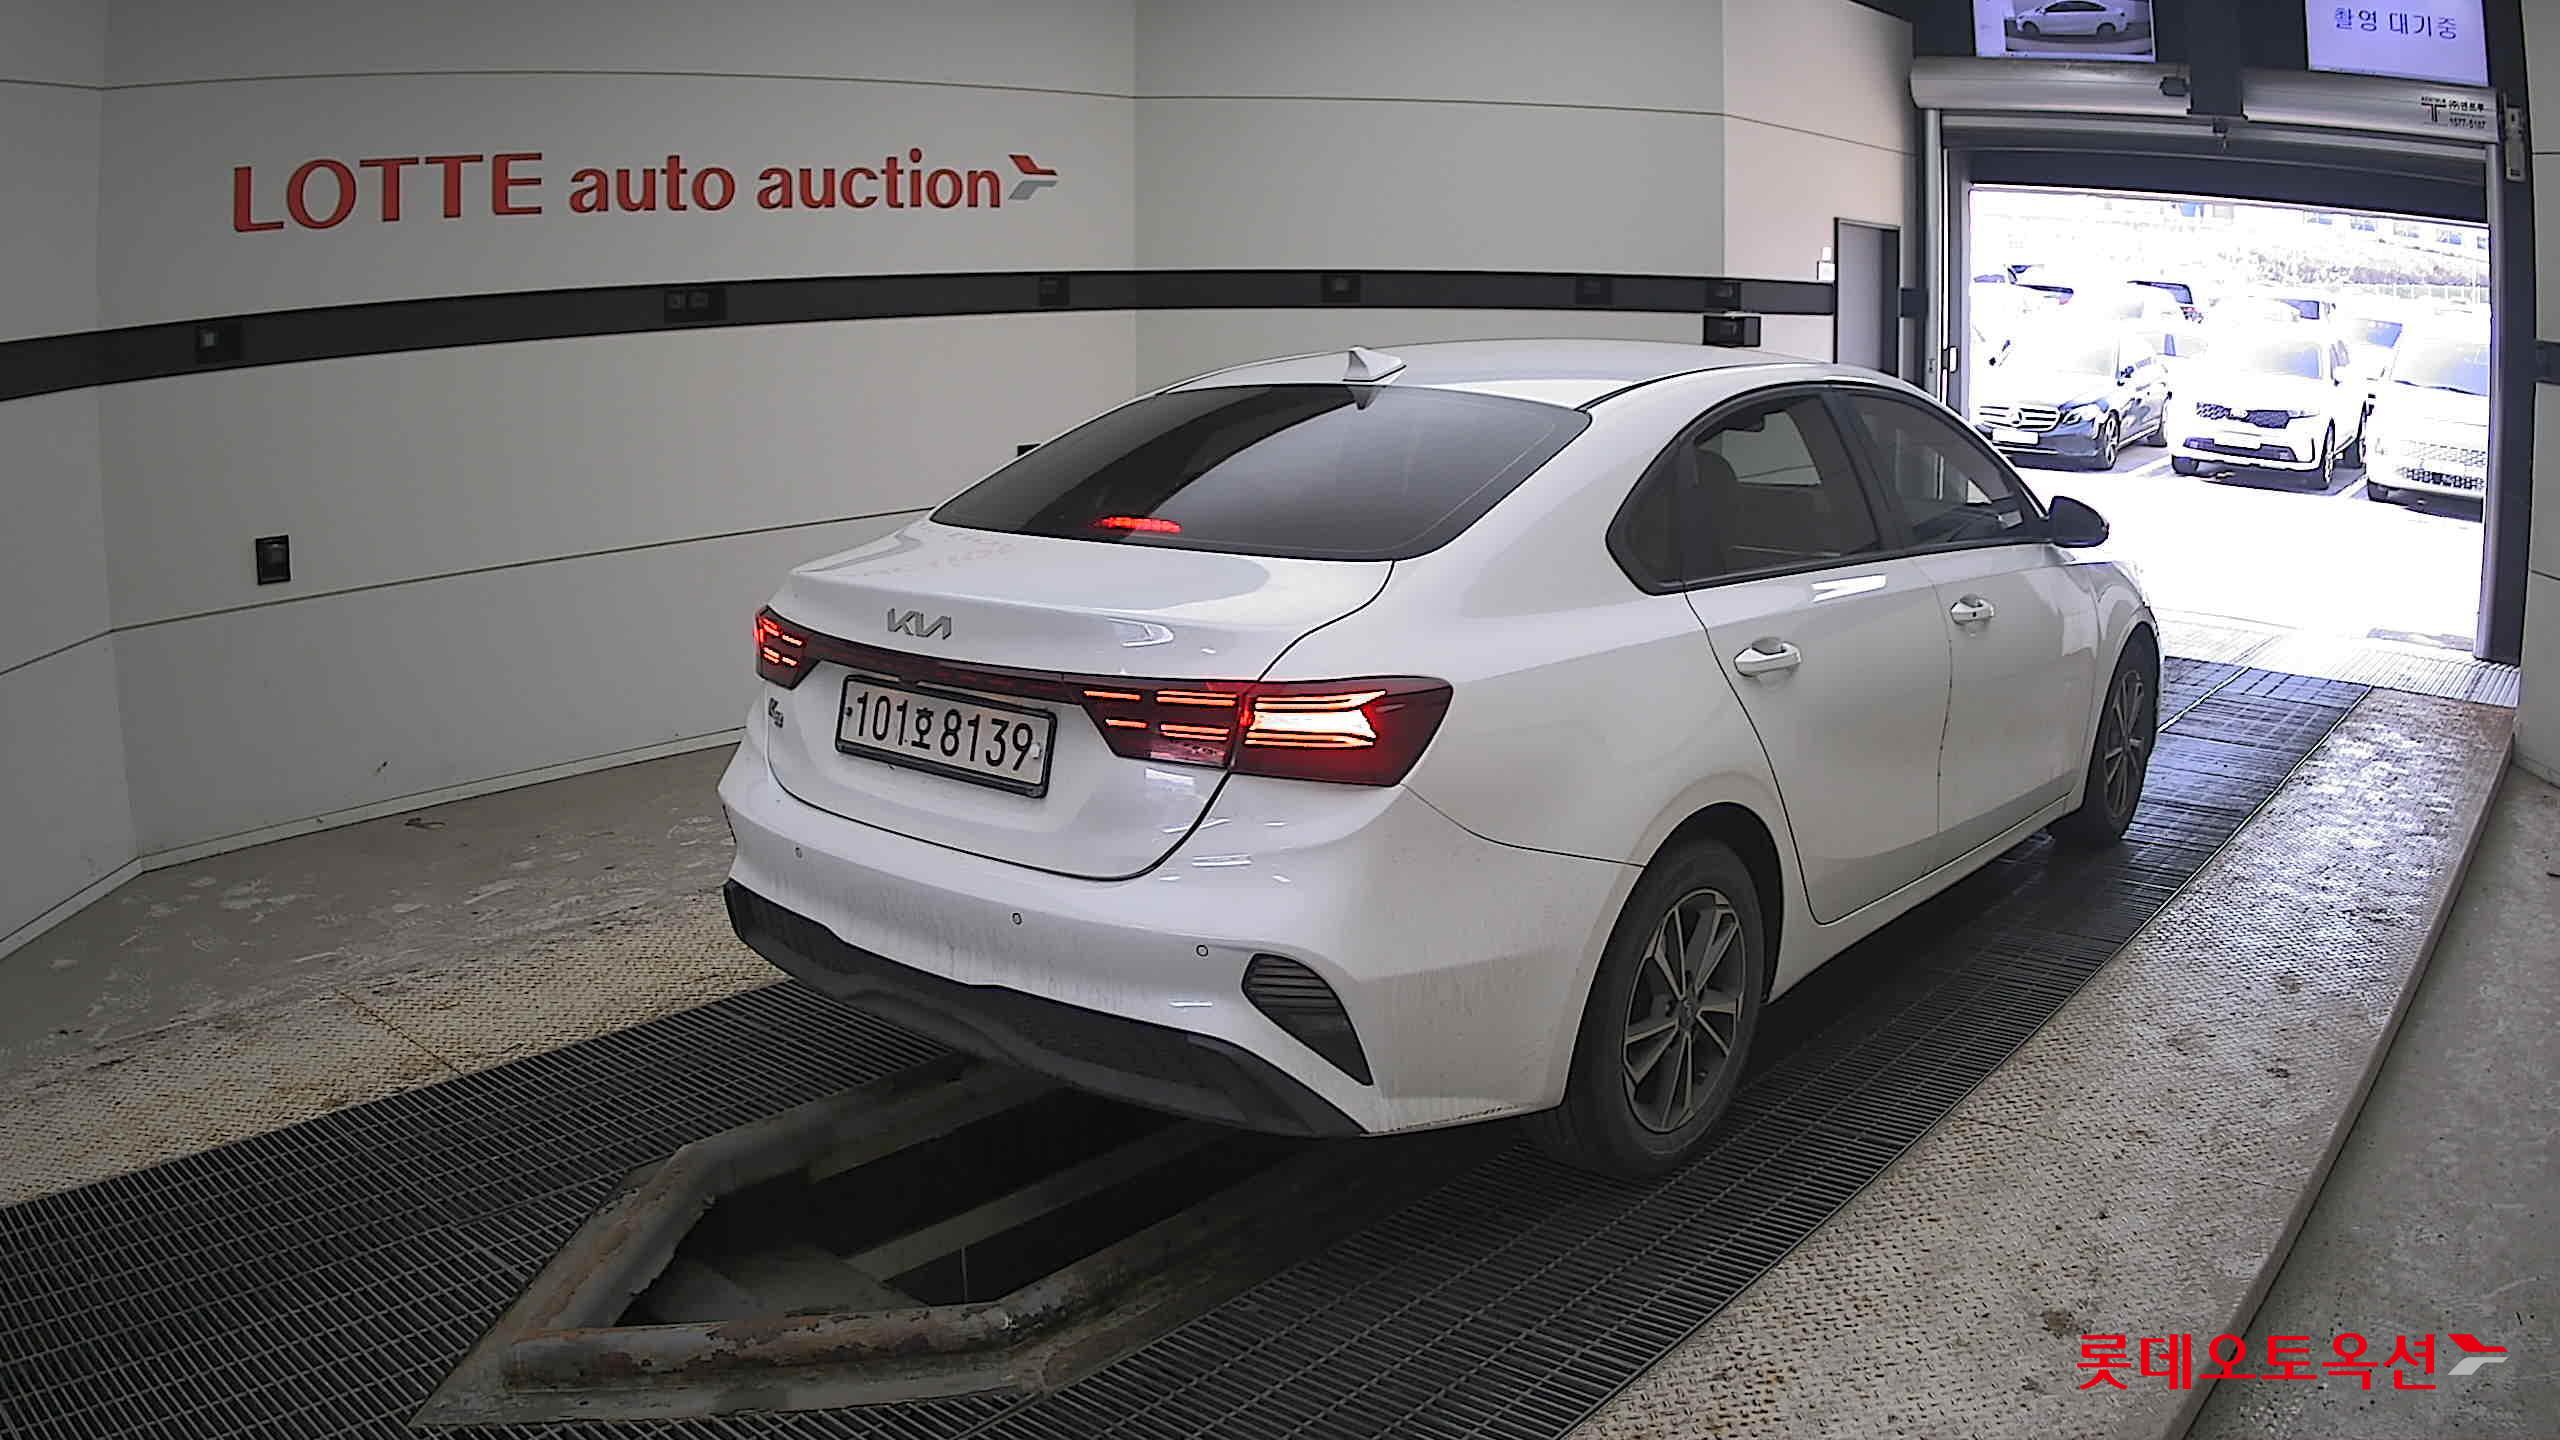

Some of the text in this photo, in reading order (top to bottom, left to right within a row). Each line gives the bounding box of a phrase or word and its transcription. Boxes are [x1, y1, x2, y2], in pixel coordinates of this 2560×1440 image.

[2389, 12, 2432, 37] 대기
[2438, 16, 2457, 40] 중
[233, 148, 1001, 233] LOTTE auto auction
[887, 607, 952, 641] KIA
